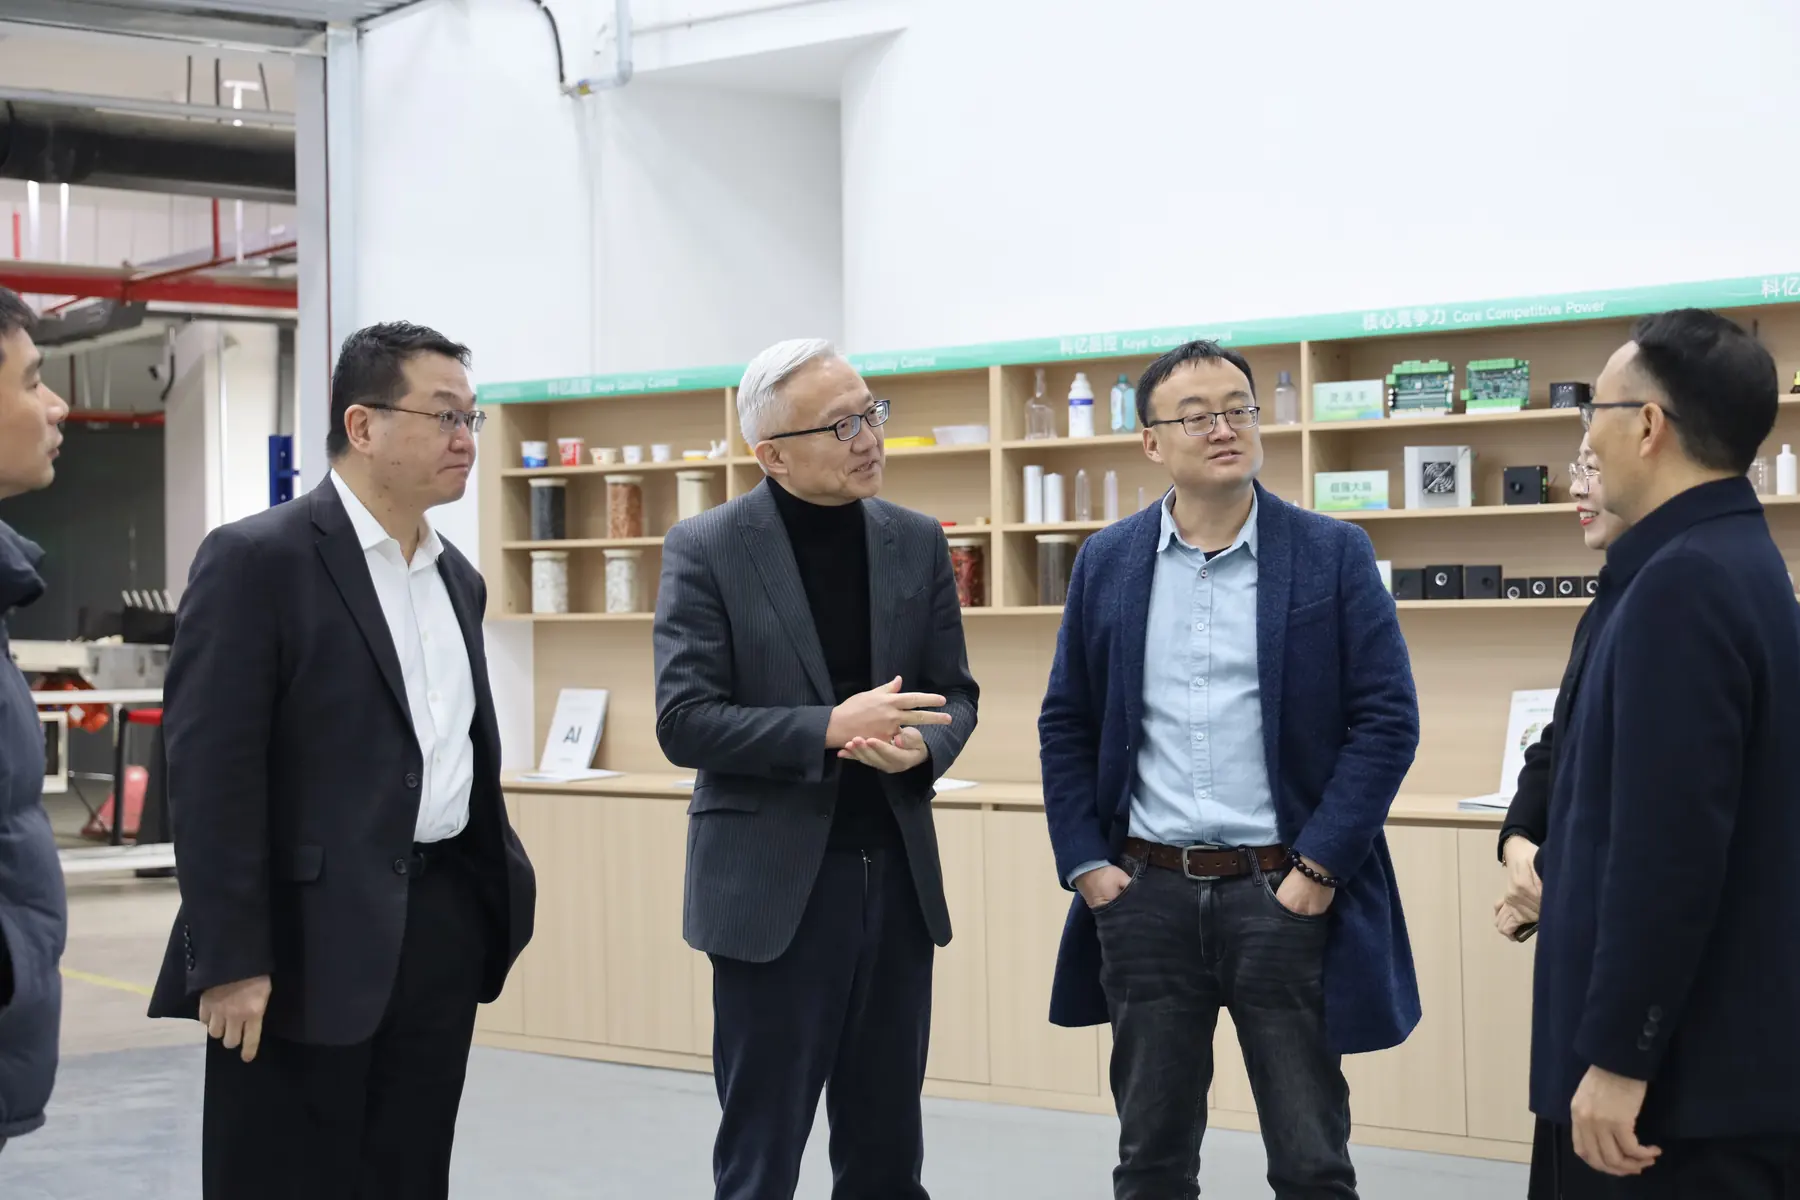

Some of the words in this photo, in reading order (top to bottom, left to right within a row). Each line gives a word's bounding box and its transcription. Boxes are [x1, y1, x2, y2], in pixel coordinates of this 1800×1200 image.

[1363, 309, 1446, 331] 核心竞争力
[1453, 309, 1482, 322] Core
[1486, 303, 1561, 320] Competitive
[1566, 300, 1605, 314] Power
[563, 725, 582, 743] AI
